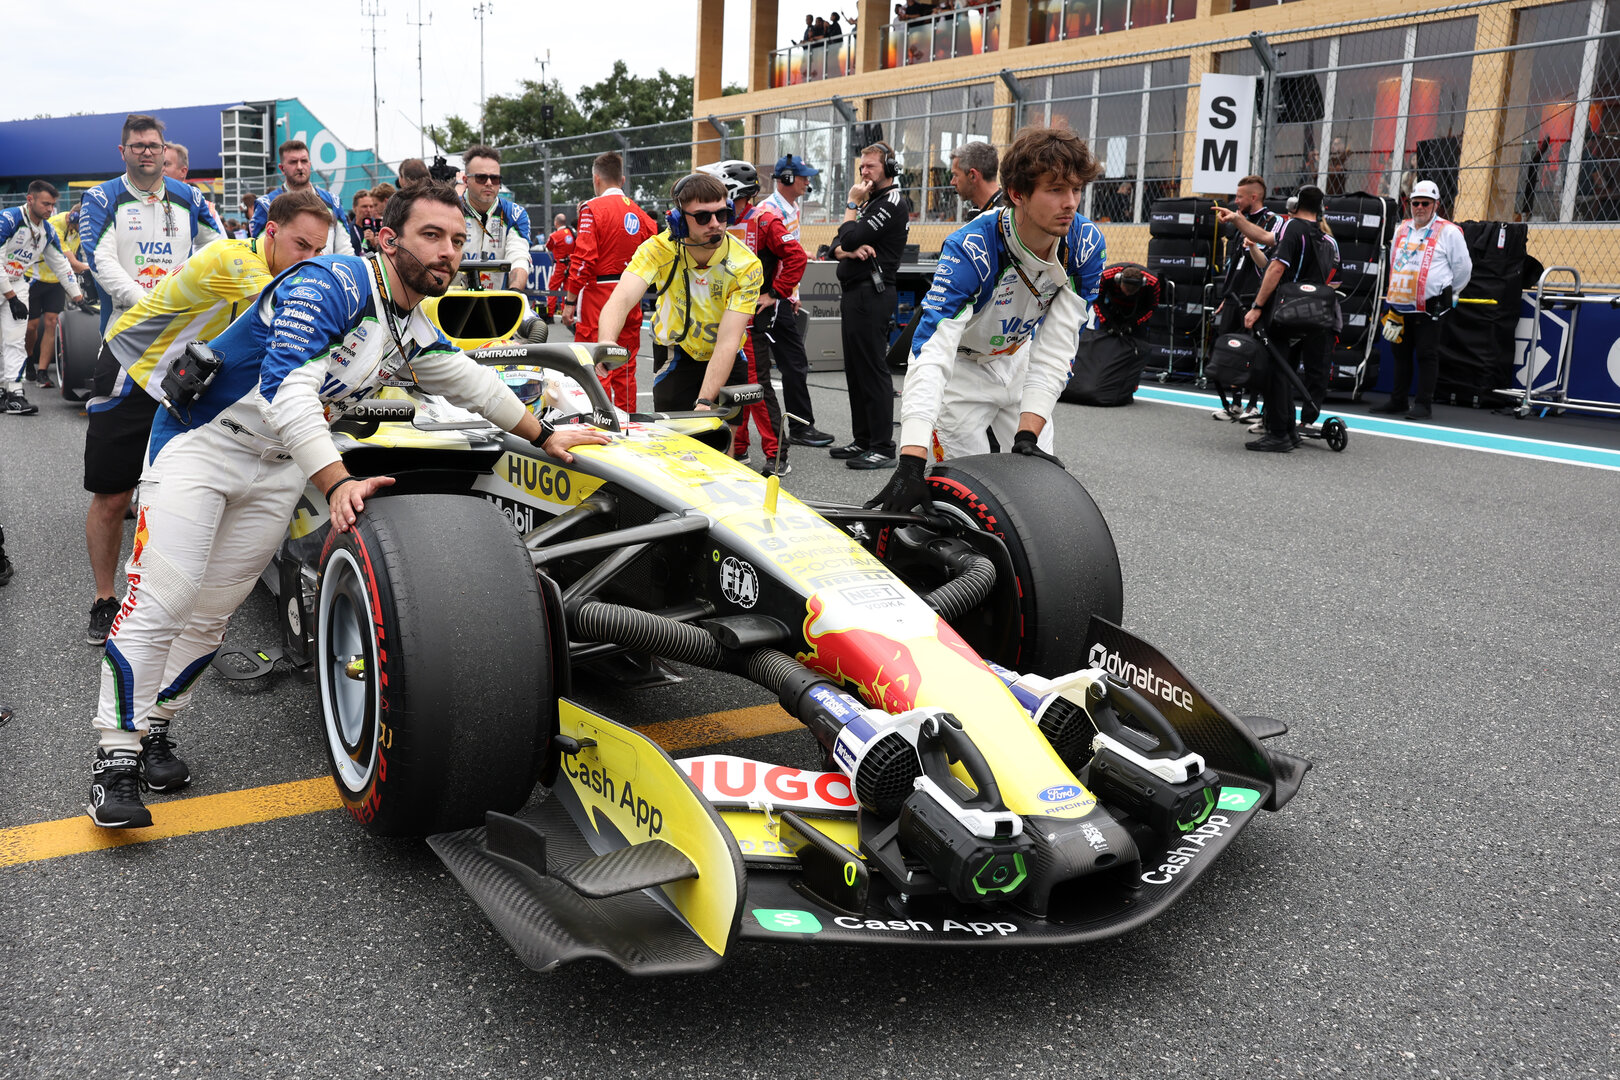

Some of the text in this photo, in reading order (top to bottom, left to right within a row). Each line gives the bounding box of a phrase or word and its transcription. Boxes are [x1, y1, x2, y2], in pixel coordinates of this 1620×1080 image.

[1208, 95, 1237, 130] S
[292, 129, 347, 196] 9
[1201, 138, 1238, 172] M
[626, 213, 637, 234] hp
[136, 241, 173, 255] VISA
[317, 281, 331, 290] App
[283, 300, 321, 313] RACING
[331, 351, 351, 368] Mobil
[478, 348, 528, 359] XMTRADING
[367, 405, 413, 417] hahnair
[508, 454, 571, 501] HUGO
[788, 534, 825, 544] Cash
[806, 569, 895, 590] PIRELLI
[848, 587, 893, 601] NEFT
[1106, 651, 1194, 712] dynatrace
[813, 689, 850, 718] Airtasker
[564, 752, 663, 838] Cash App
[1046, 785, 1076, 801] Ford
[1045, 799, 1096, 815] RACING
[1141, 815, 1232, 885] Cash App
[833, 916, 934, 933] Cash
[942, 918, 1019, 936] App
